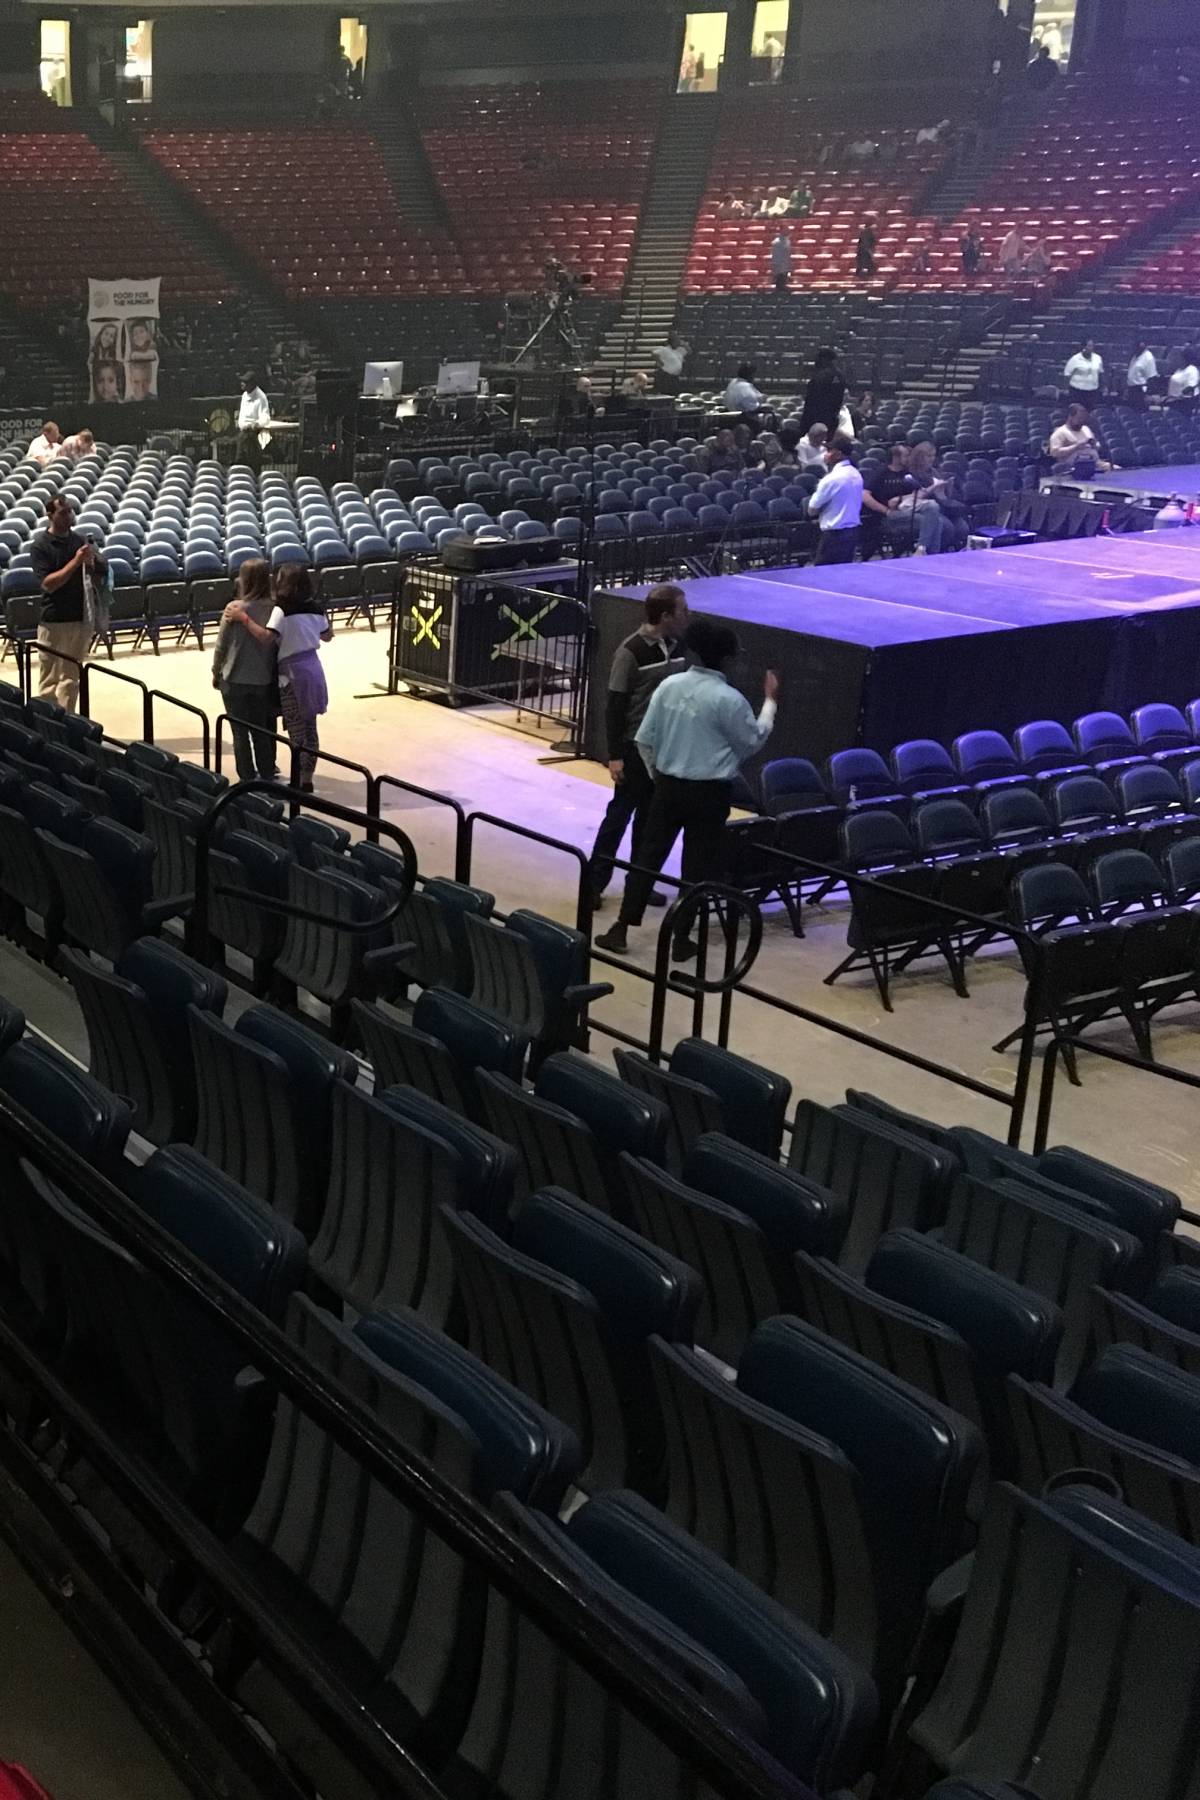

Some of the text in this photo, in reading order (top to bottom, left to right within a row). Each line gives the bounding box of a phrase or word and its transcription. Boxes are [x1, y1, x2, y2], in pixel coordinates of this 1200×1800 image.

[113, 291, 149, 300] FOOD FOR
[24, 418, 43, 427] FOR
